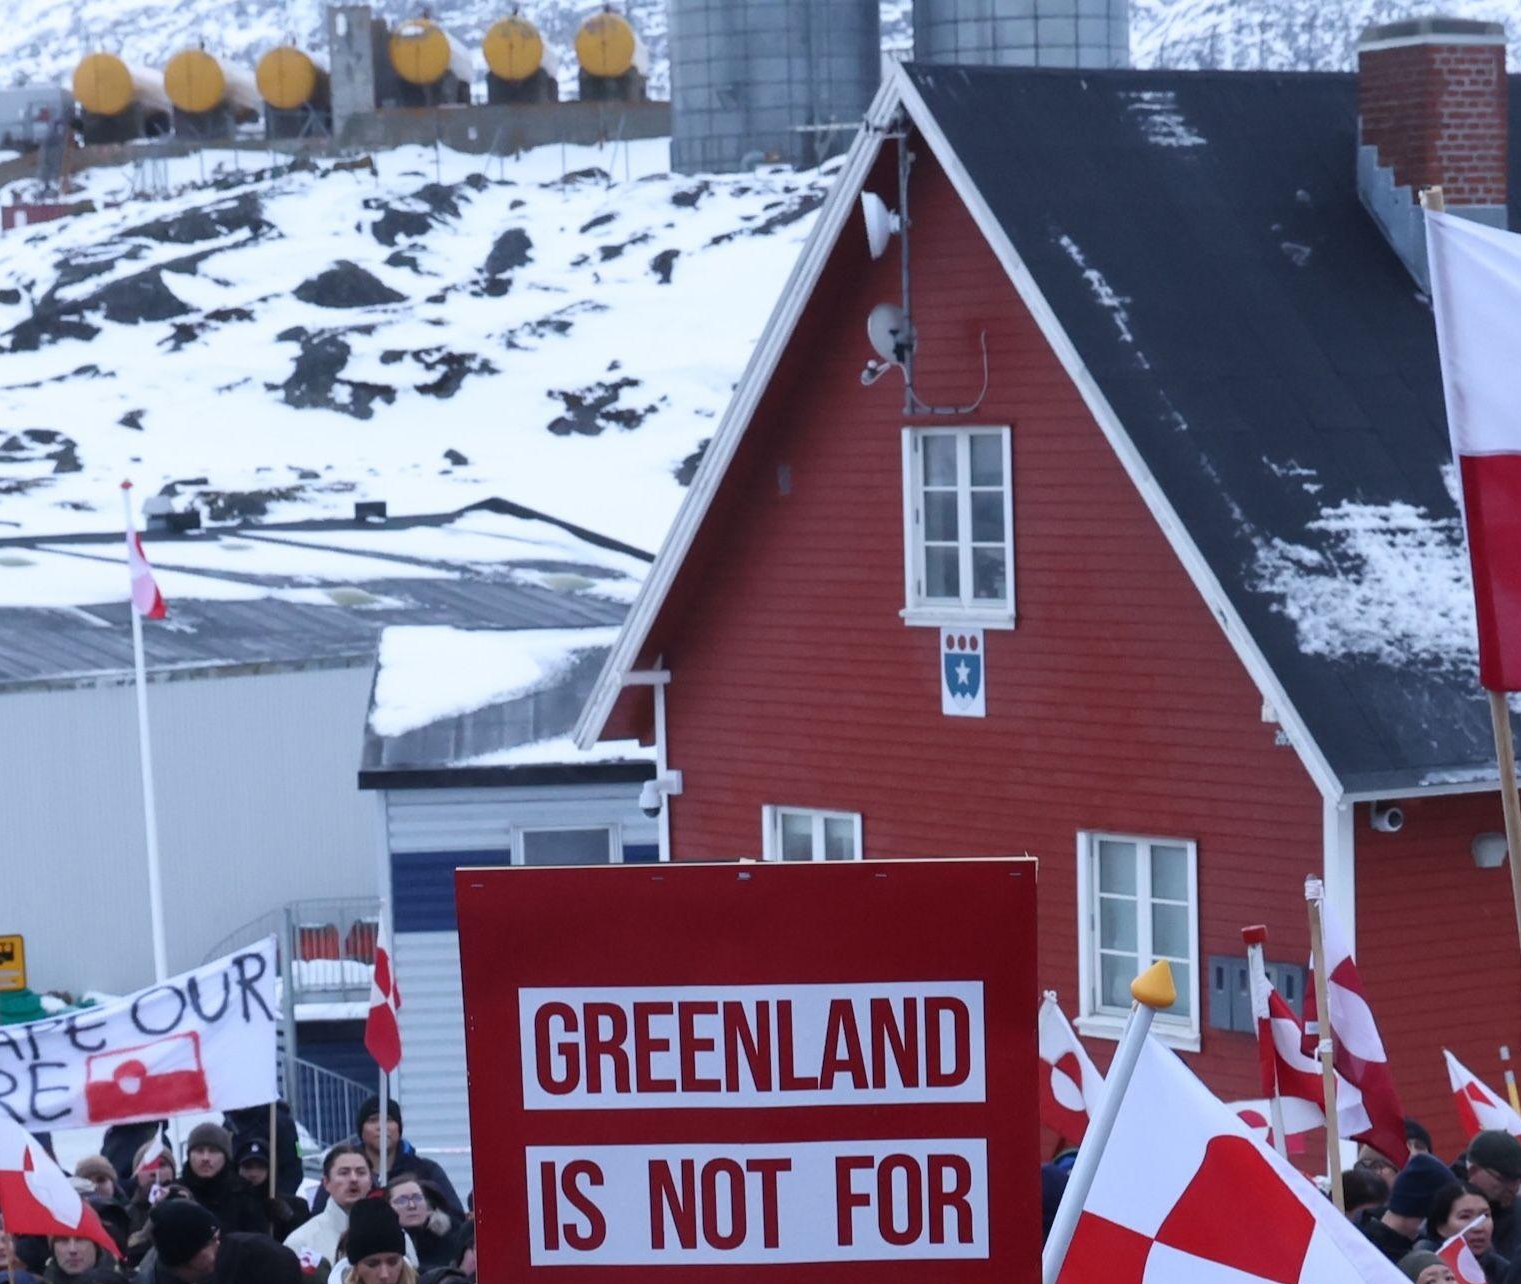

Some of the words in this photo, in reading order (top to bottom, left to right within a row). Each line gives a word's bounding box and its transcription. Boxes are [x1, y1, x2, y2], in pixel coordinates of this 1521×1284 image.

[131, 952, 275, 1035] OUR
[534, 996, 971, 1095] GREENLAND
[540, 1159, 607, 1251] IS
[648, 1157, 792, 1250] NOT
[835, 1153, 974, 1246] FOR
